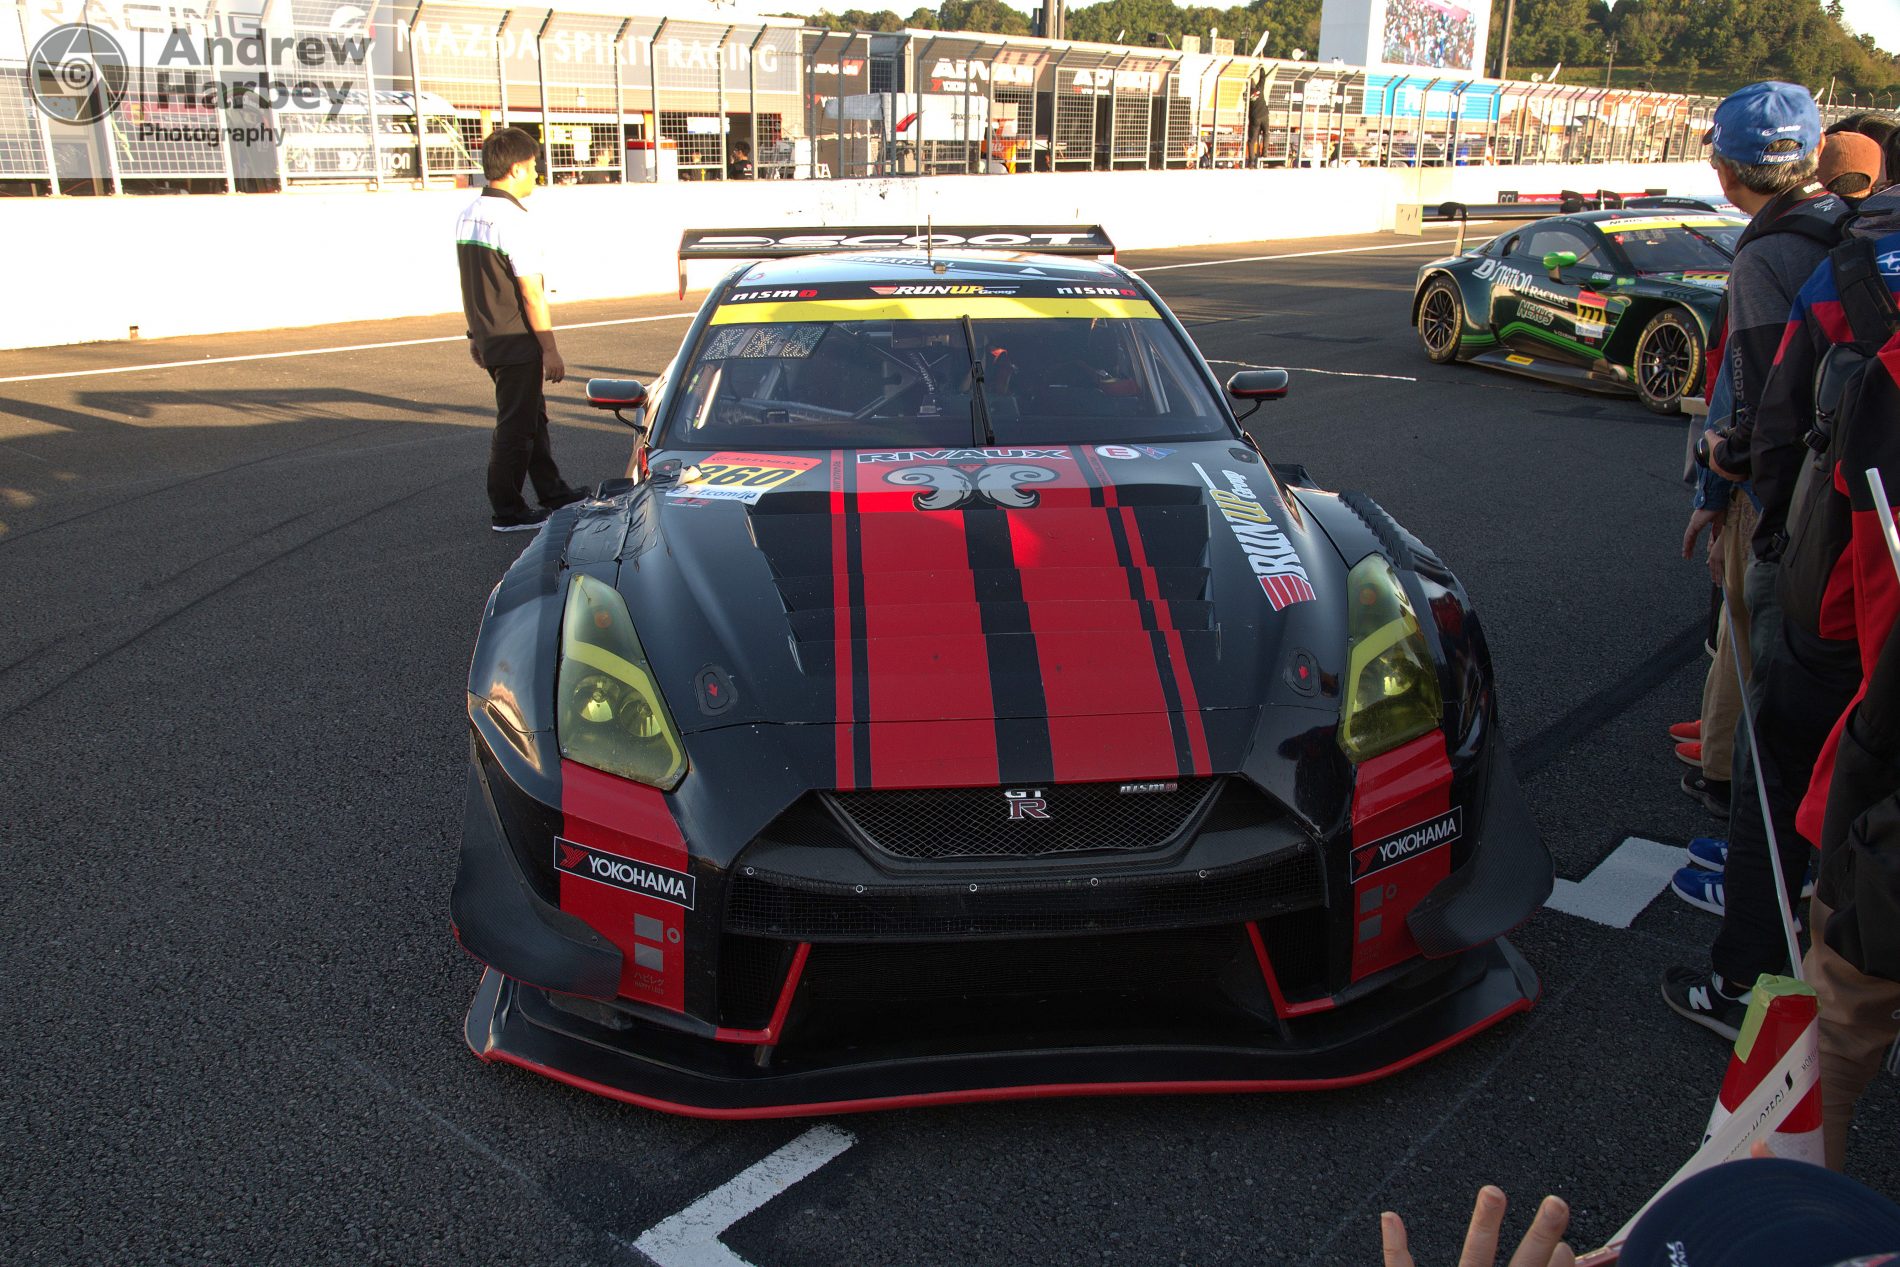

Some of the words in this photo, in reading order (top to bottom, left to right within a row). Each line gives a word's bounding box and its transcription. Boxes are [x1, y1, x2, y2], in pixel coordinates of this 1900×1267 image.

[397, 18, 540, 61] MAZDA
[553, 30, 651, 66] SPIRIT
[668, 38, 778, 73] RACING
[1516, 299, 1554, 326] NEXUS
[856, 449, 1073, 464] RIVAUX
[1209, 489, 1309, 582] RUNUP
[1379, 817, 1457, 863] YOKOHAMA
[588, 854, 687, 900] YOKOHAMA
